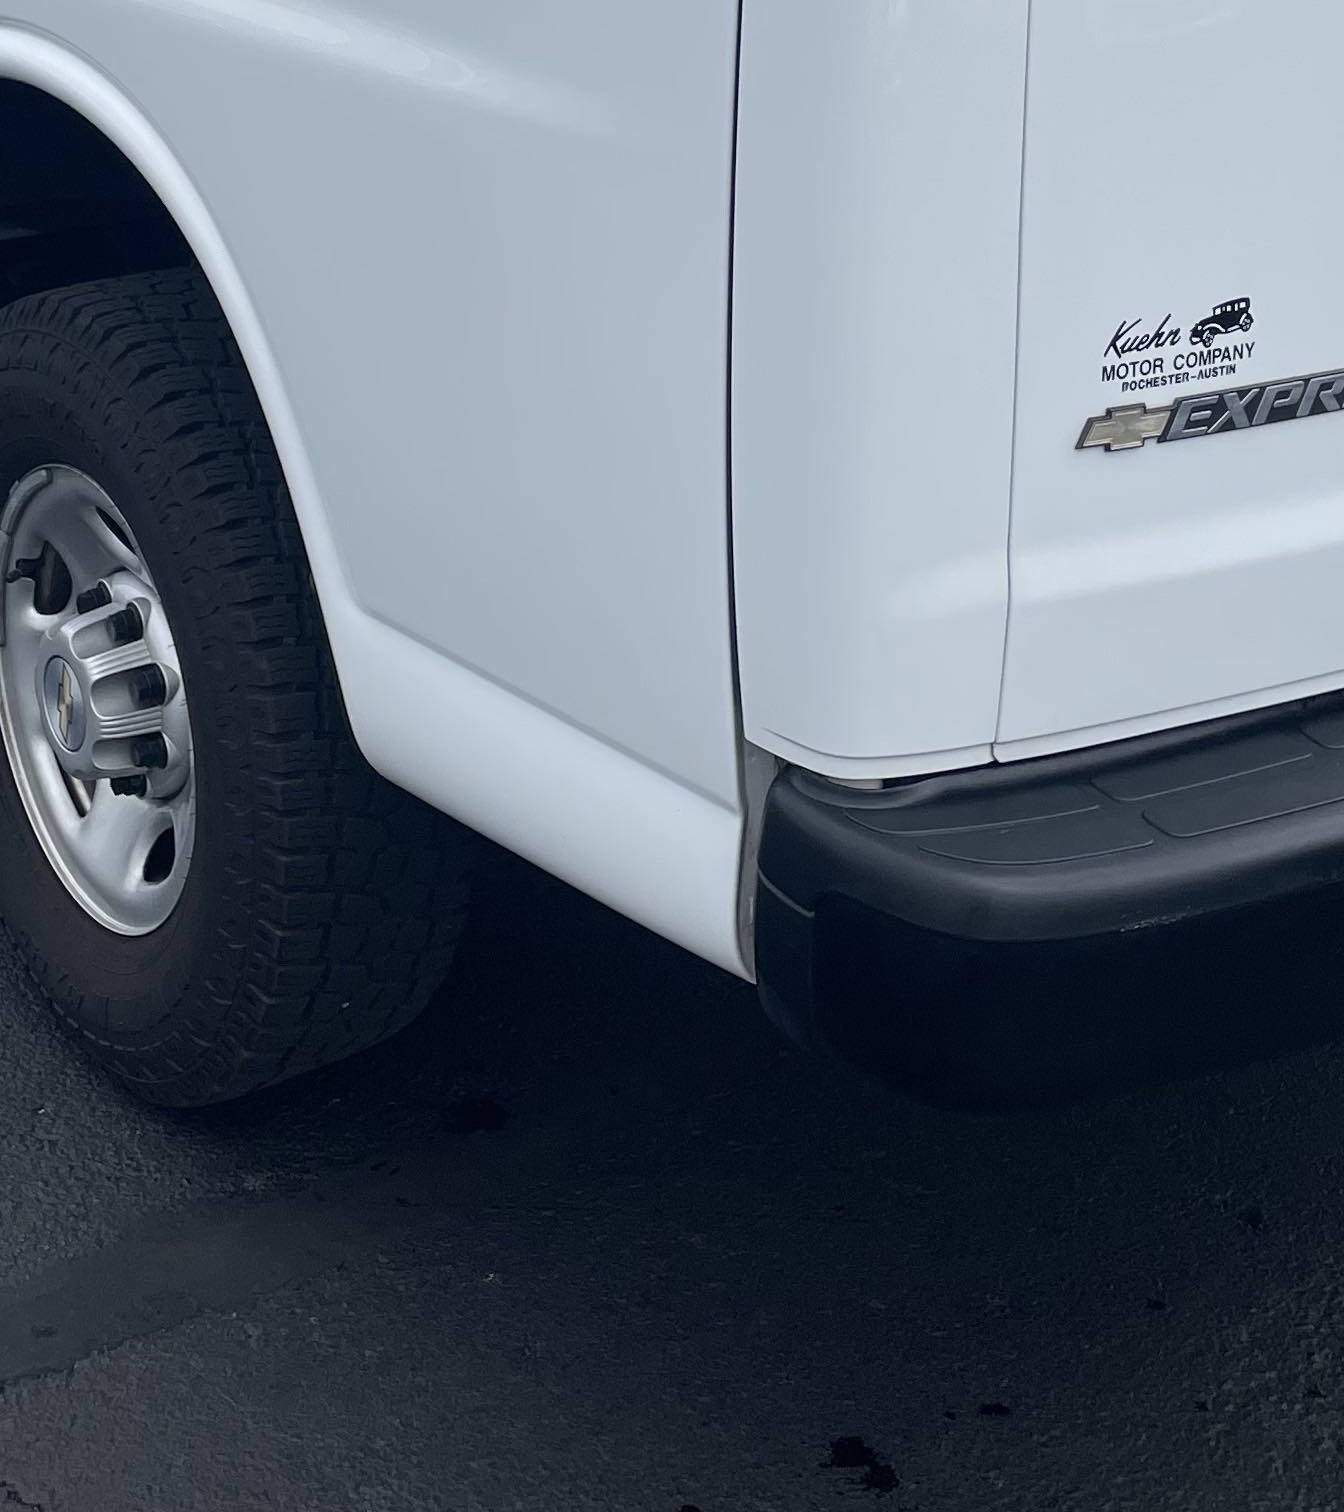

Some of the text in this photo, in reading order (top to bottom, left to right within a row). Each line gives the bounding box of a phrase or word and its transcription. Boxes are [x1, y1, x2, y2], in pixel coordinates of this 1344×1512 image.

[1104, 313, 1181, 358] Kuehn
[1101, 341, 1256, 382] MOTOR COMPANY
